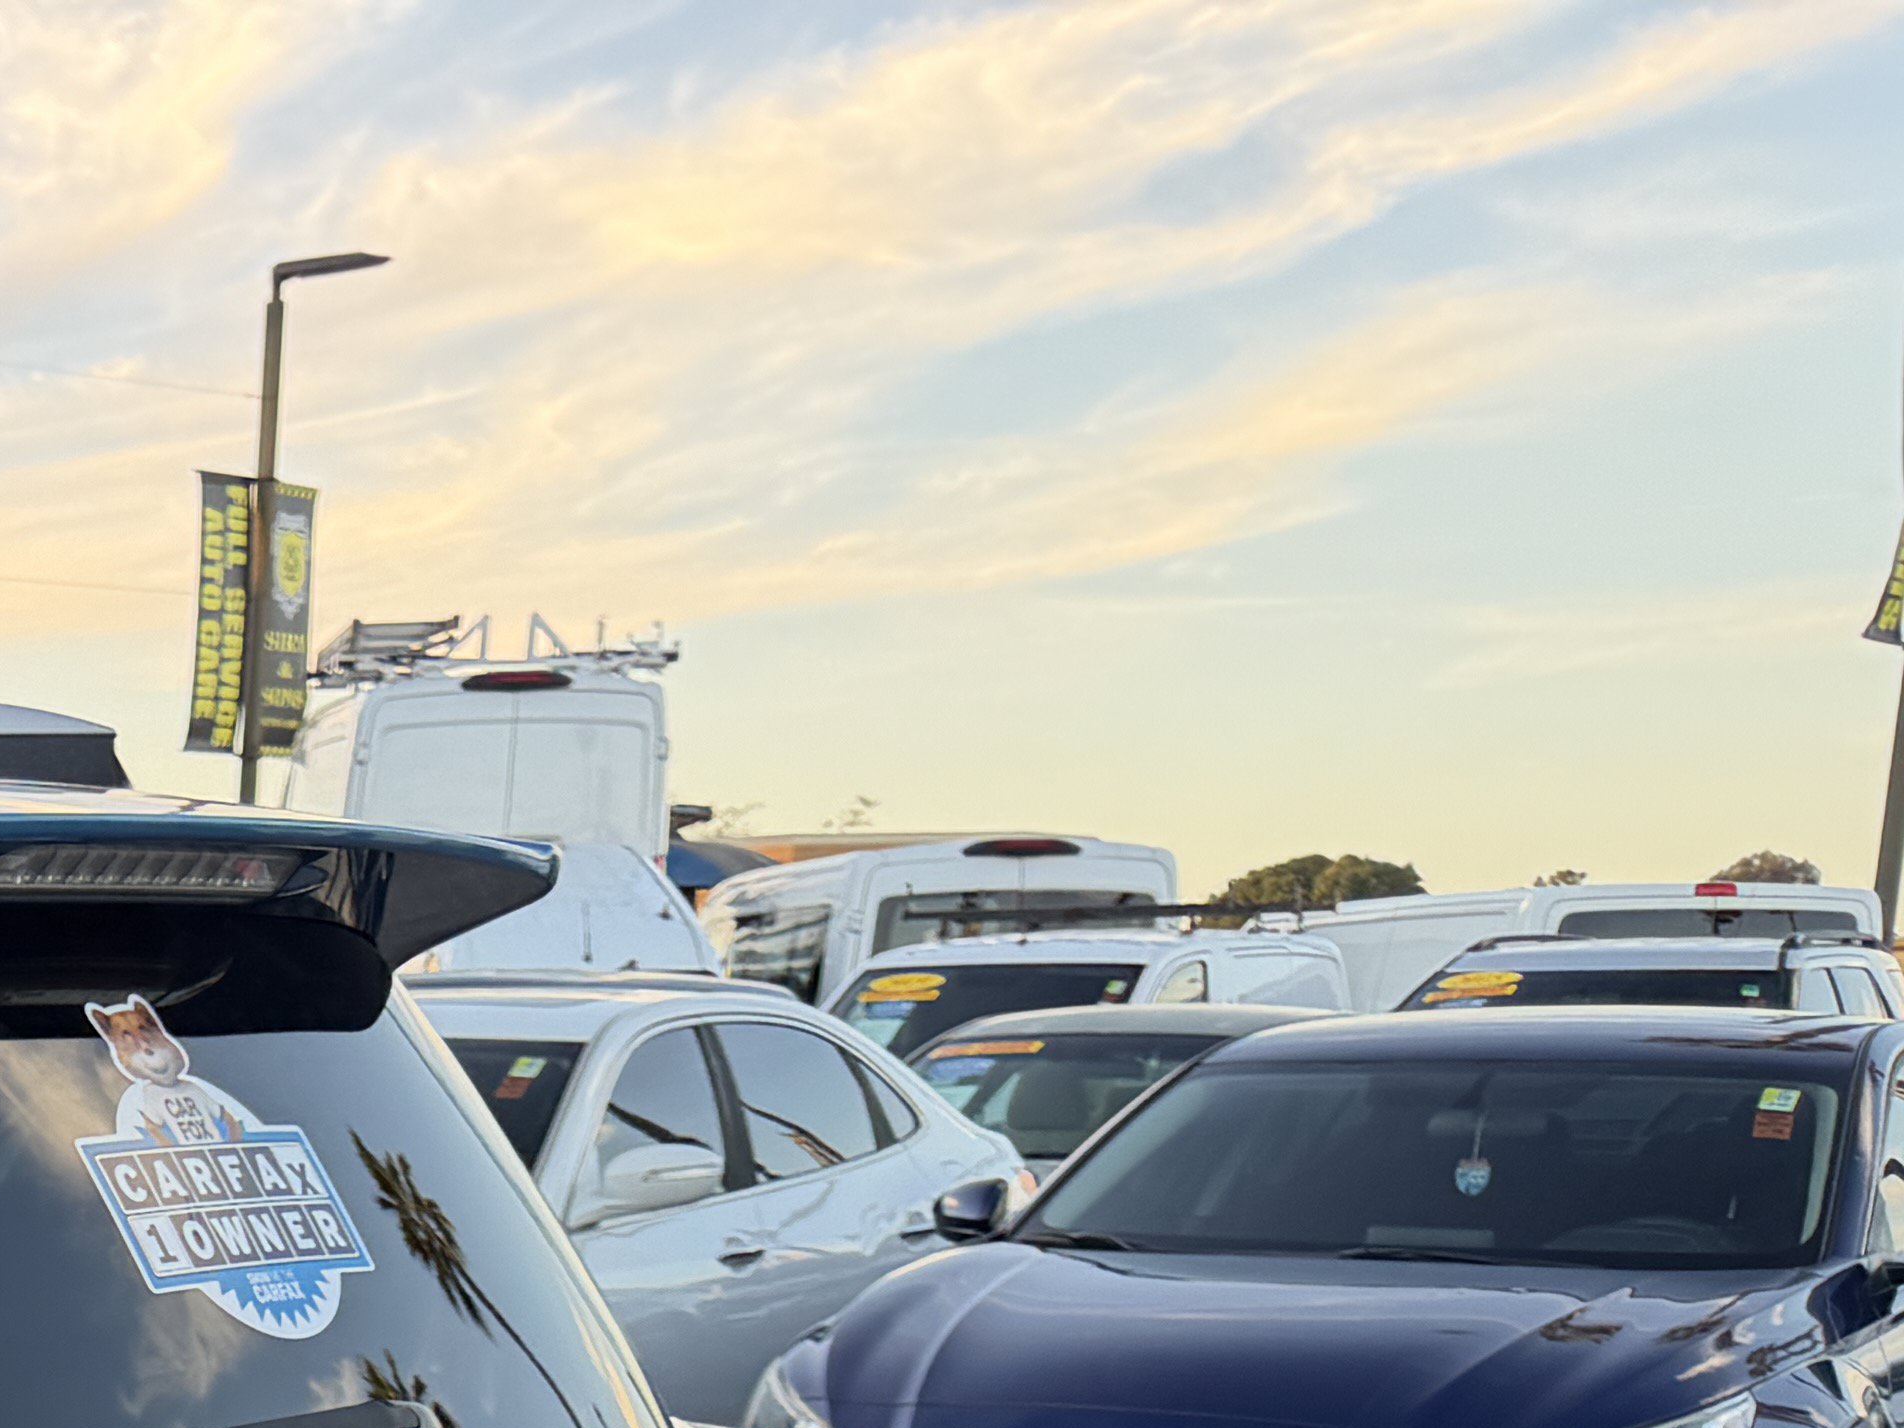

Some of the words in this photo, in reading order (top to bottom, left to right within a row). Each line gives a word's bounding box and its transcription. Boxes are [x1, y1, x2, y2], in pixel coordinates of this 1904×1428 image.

[200, 507, 224, 612] AUTO
[194, 618, 221, 719] CARE
[210, 587, 246, 747] SERVICE
[165, 1097, 202, 1120] CAR
[177, 1121, 213, 1143] FOX
[115, 1153, 317, 1203] CARFAX
[146, 1221, 177, 1263] 1
[182, 1210, 347, 1261] OWNER
